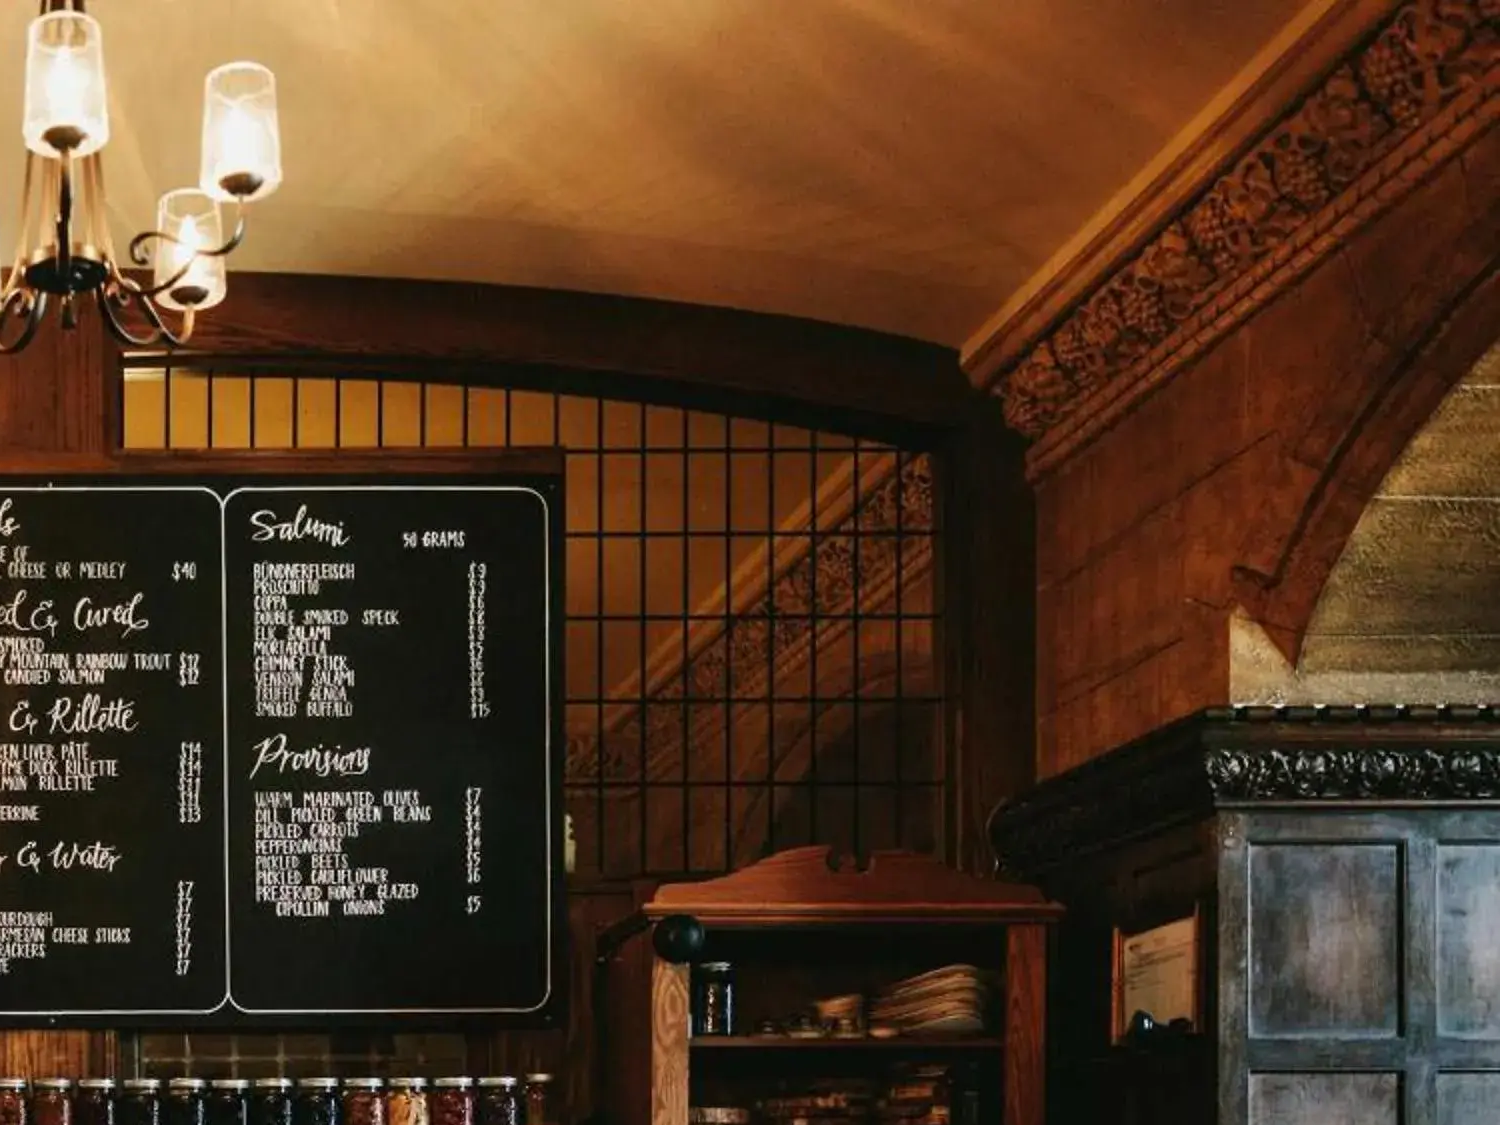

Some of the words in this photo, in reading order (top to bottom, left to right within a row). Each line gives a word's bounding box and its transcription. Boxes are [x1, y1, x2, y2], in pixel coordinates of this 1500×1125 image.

[249, 504, 352, 547] Salumi
[402, 531, 418, 549] 50
[422, 531, 466, 549] GRAMS
[55, 561, 72, 579] OR
[171, 561, 197, 581] $40
[73, 592, 150, 639] Cured
[361, 609, 401, 626] SPECK
[287, 625, 331, 641] SALAMI
[134, 653, 172, 671] TROUT
[314, 655, 349, 671] STICK
[57, 668, 106, 685] SALMON
[45, 693, 140, 735] Rillette
[306, 701, 354, 718] BUFFALO
[249, 732, 372, 780] Provisions
[39, 775, 96, 791] RILLETTE
[303, 790, 376, 808] MARINATED
[255, 806, 278, 823] DILL
[393, 805, 432, 823] BEANS
[47, 840, 123, 873] Water
[311, 854, 350, 870] BEETS
[255, 884, 323, 902] PRESERVED
[52, 927, 89, 944] CHEESE
[95, 927, 132, 944] STICKS
